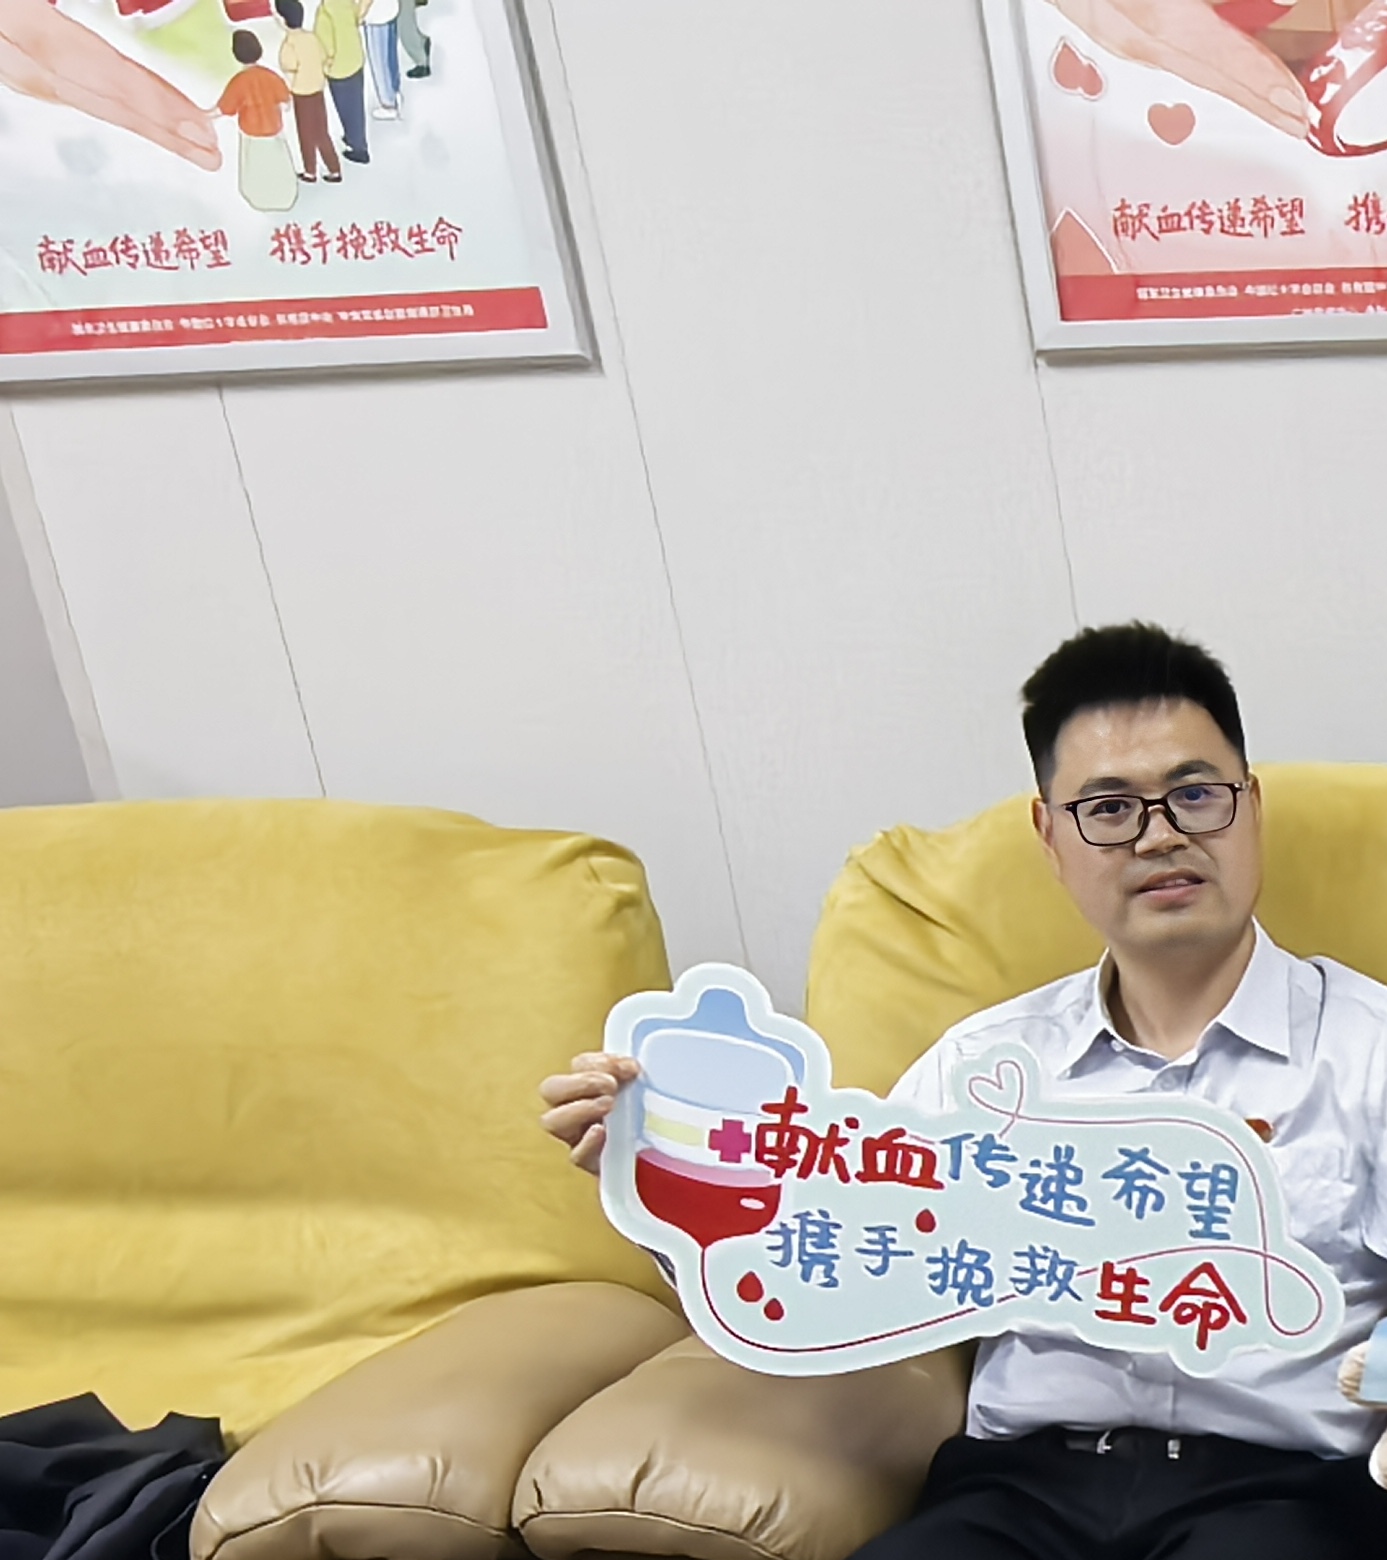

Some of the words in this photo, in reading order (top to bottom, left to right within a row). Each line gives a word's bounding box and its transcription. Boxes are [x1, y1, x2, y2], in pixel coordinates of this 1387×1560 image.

[37, 226, 231, 277] 献血传递希望
[269, 216, 463, 265] 携手挽救生命
[1112, 195, 1305, 243] 献血传递希望
[755, 1086, 1241, 1241] 献血传递希望
[765, 1209, 1248, 1352] 携手挽救生命
